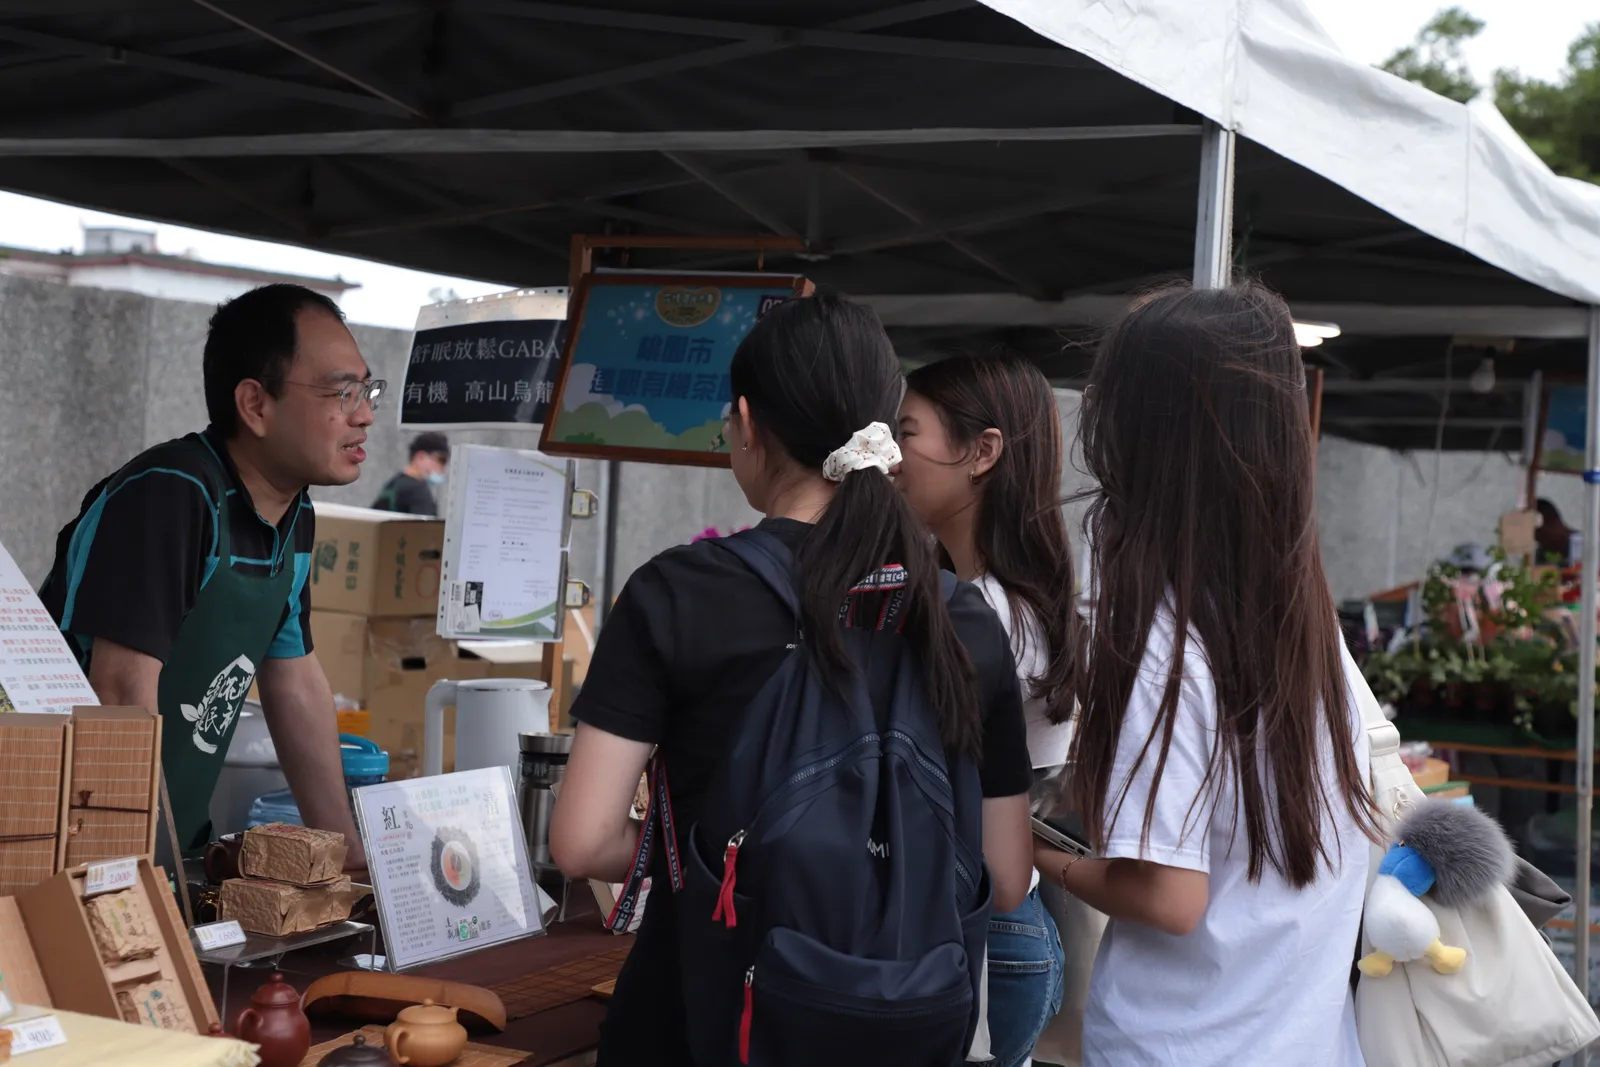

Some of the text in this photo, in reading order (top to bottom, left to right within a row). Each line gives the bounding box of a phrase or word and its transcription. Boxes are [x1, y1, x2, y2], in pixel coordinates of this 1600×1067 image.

[636, 334, 715, 364] 桃園市
[405, 380, 449, 404] 有機
[634, 821, 654, 878] HILFIGER
